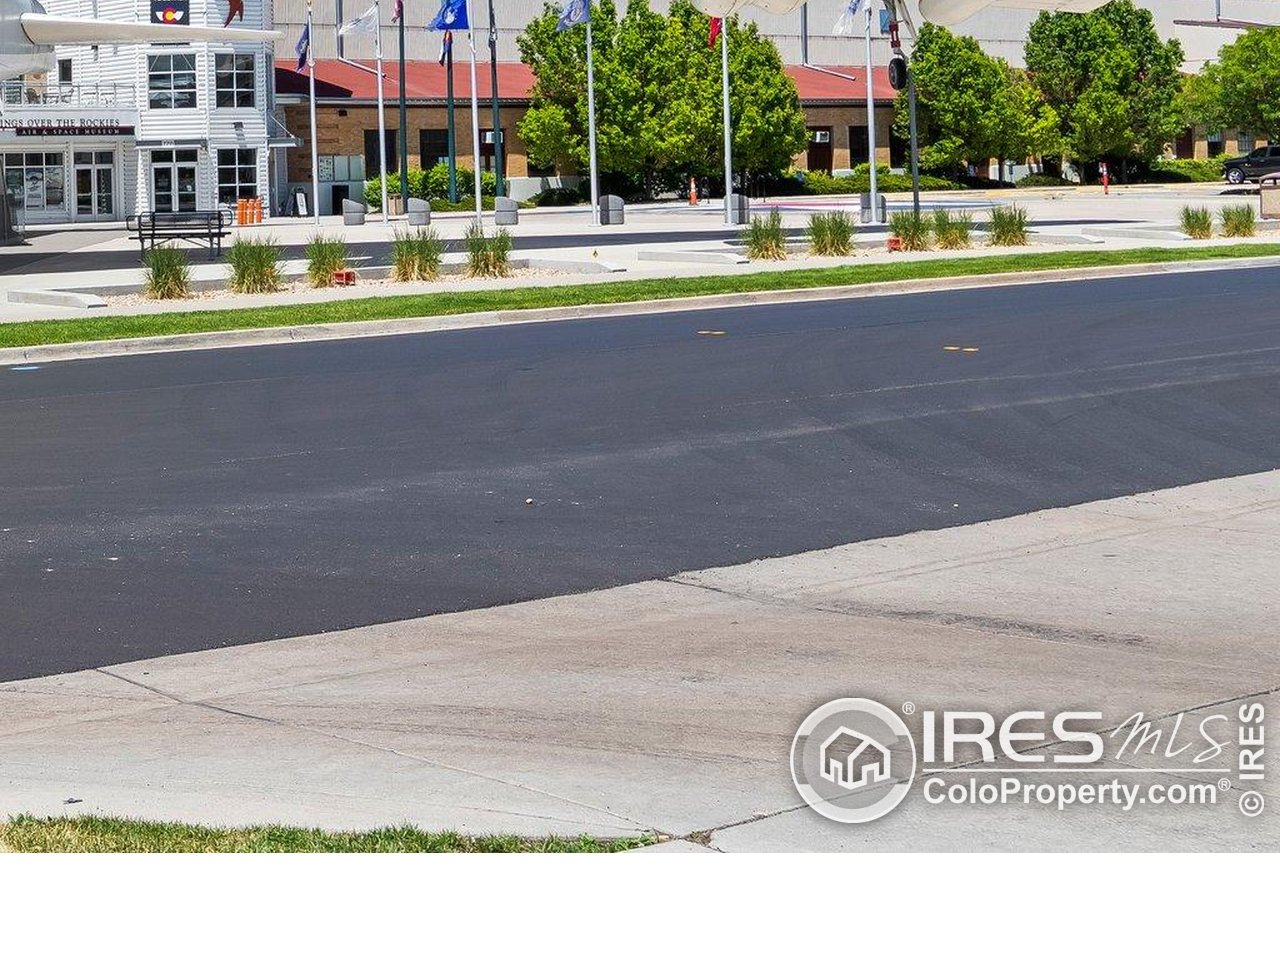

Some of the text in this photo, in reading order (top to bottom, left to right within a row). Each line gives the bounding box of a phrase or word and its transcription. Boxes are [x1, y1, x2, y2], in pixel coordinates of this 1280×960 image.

[27, 119, 53, 127] OVER
[56, 119, 75, 127] THE
[80, 118, 120, 127] ROCKIES
